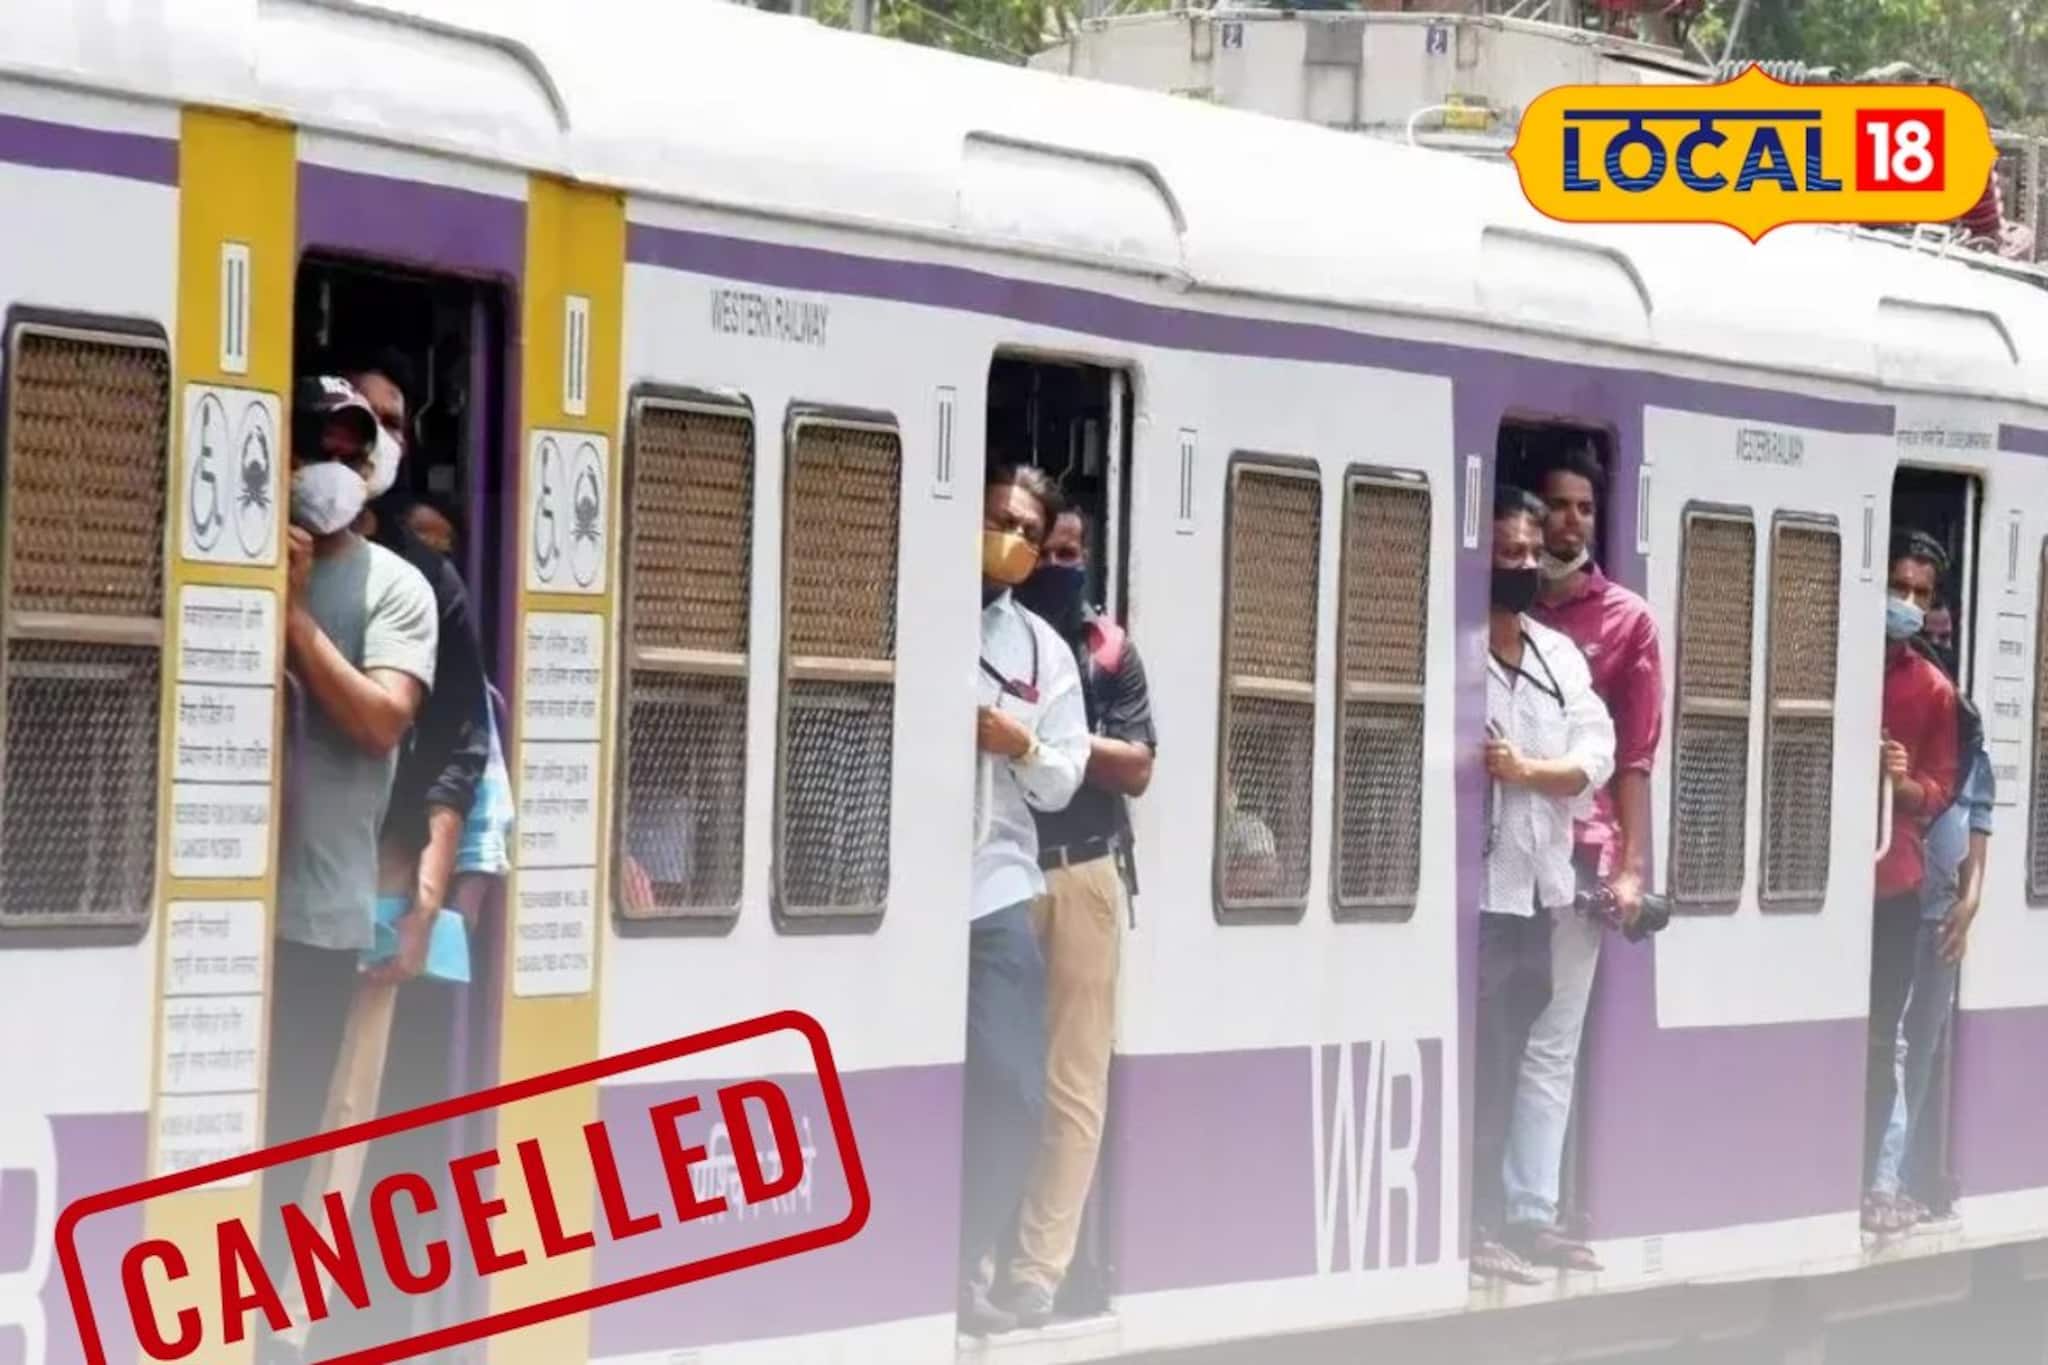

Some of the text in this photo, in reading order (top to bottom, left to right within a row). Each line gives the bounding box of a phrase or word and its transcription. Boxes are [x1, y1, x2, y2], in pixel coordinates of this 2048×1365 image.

[710, 288, 829, 347] WESTERN RAILWAY
[1311, 1038, 1424, 1275] WR
